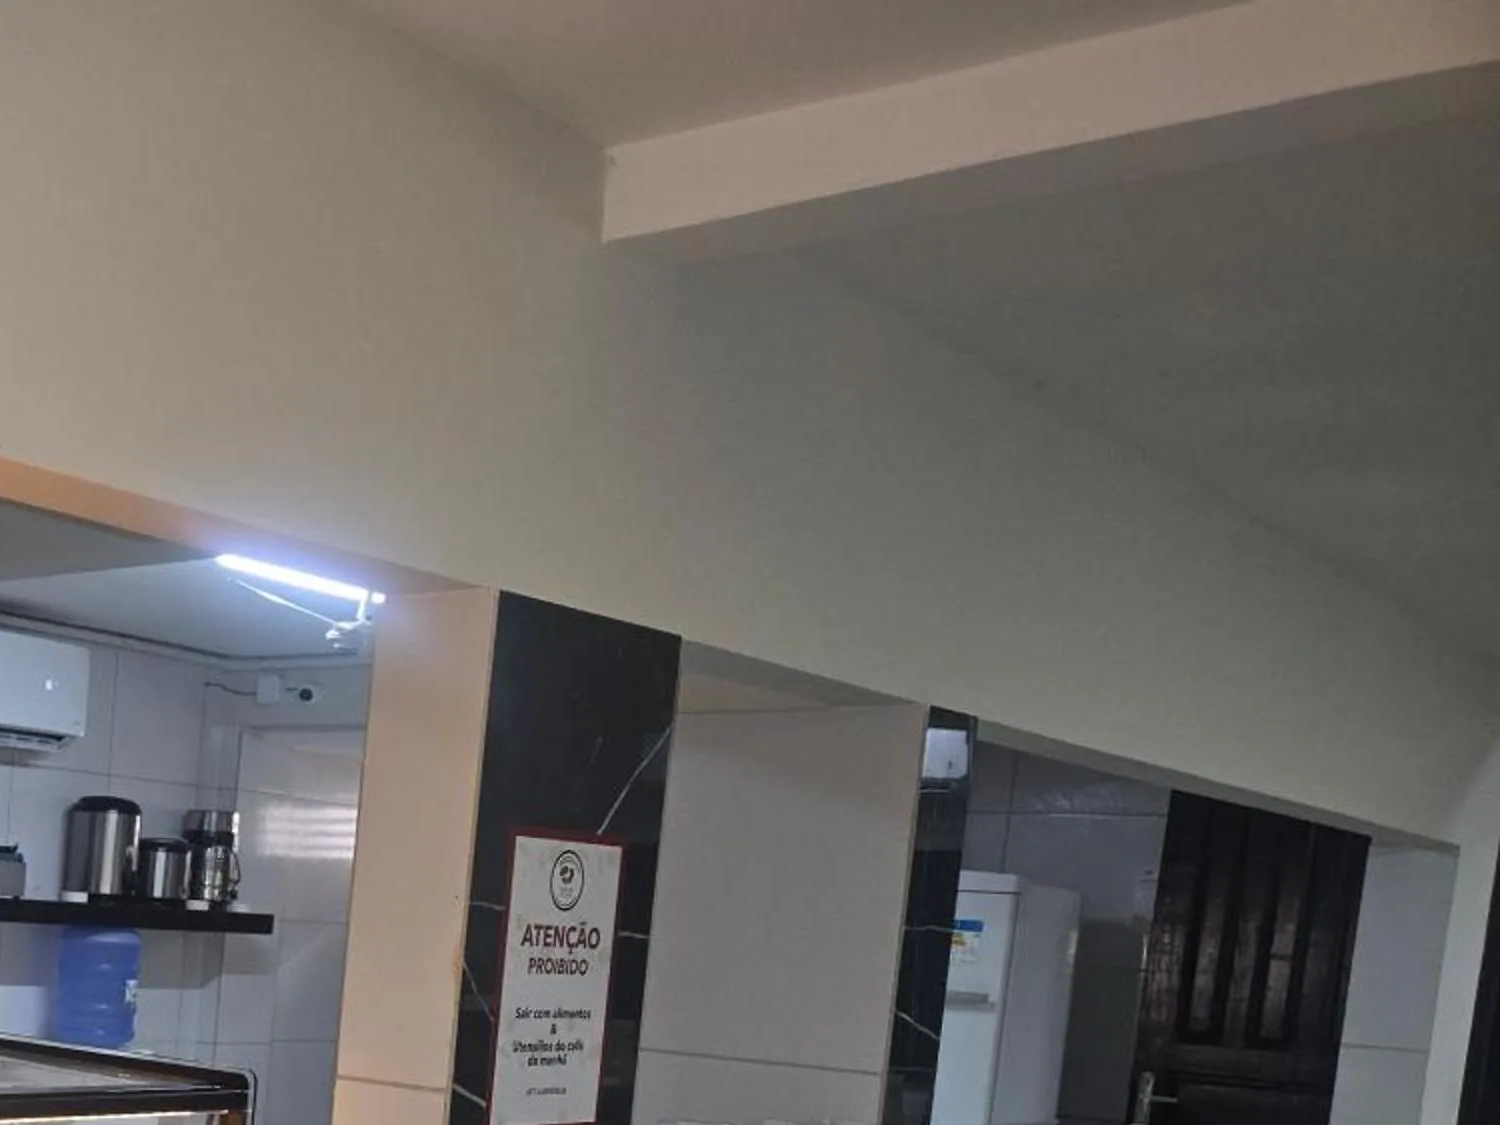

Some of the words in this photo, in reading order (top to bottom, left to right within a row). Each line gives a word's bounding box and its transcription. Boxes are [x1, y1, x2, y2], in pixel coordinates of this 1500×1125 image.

[520, 921, 601, 954] ATENÇÃO
[527, 957, 589, 976] PROIBIDO
[515, 1007, 533, 1020] Sair
[533, 1010, 551, 1020] com
